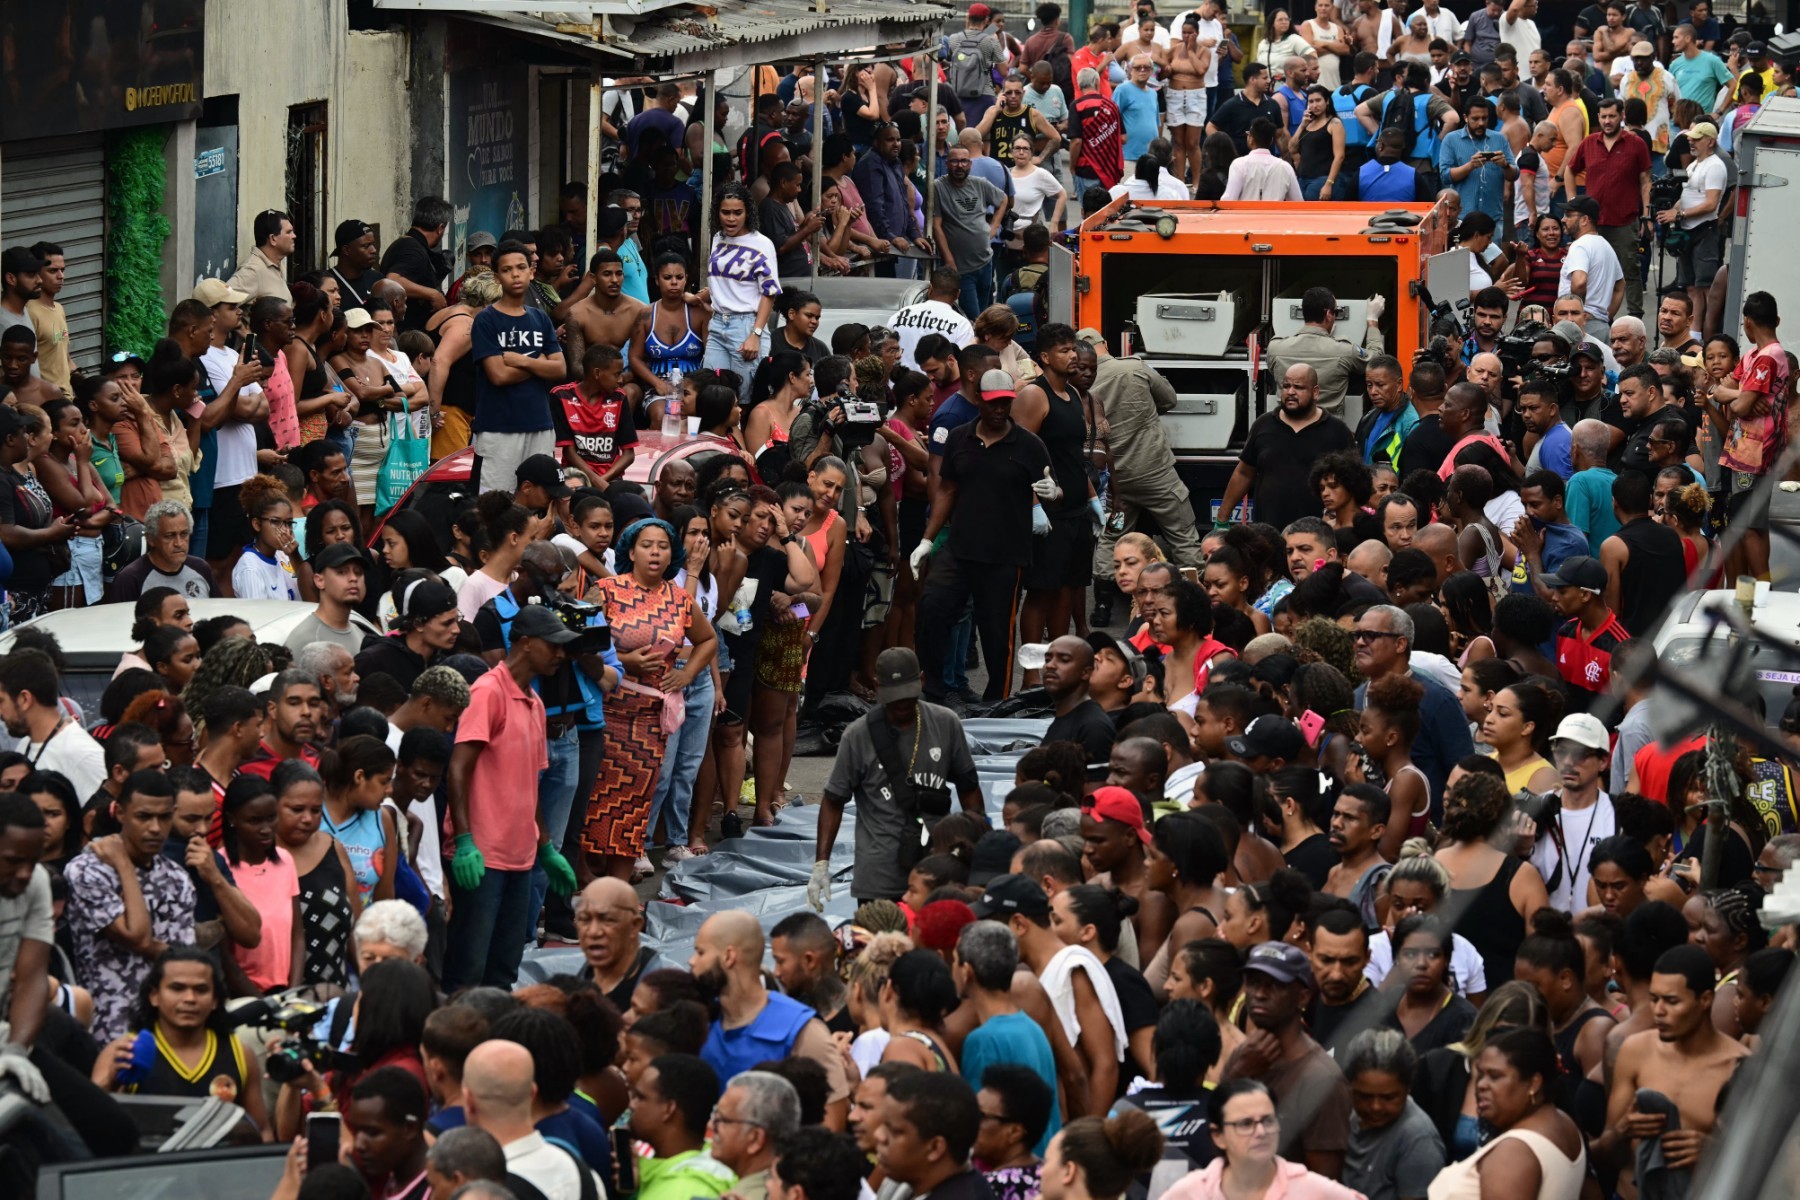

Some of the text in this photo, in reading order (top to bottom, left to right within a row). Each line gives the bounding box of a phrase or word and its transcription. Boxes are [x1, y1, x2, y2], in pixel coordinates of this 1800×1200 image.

[467, 111, 513, 147] MUNDO
[893, 308, 958, 335] Believe
[497, 329, 543, 348] NIKE
[586, 436, 613, 452] BRB
[1765, 672, 1788, 681] SEJA
